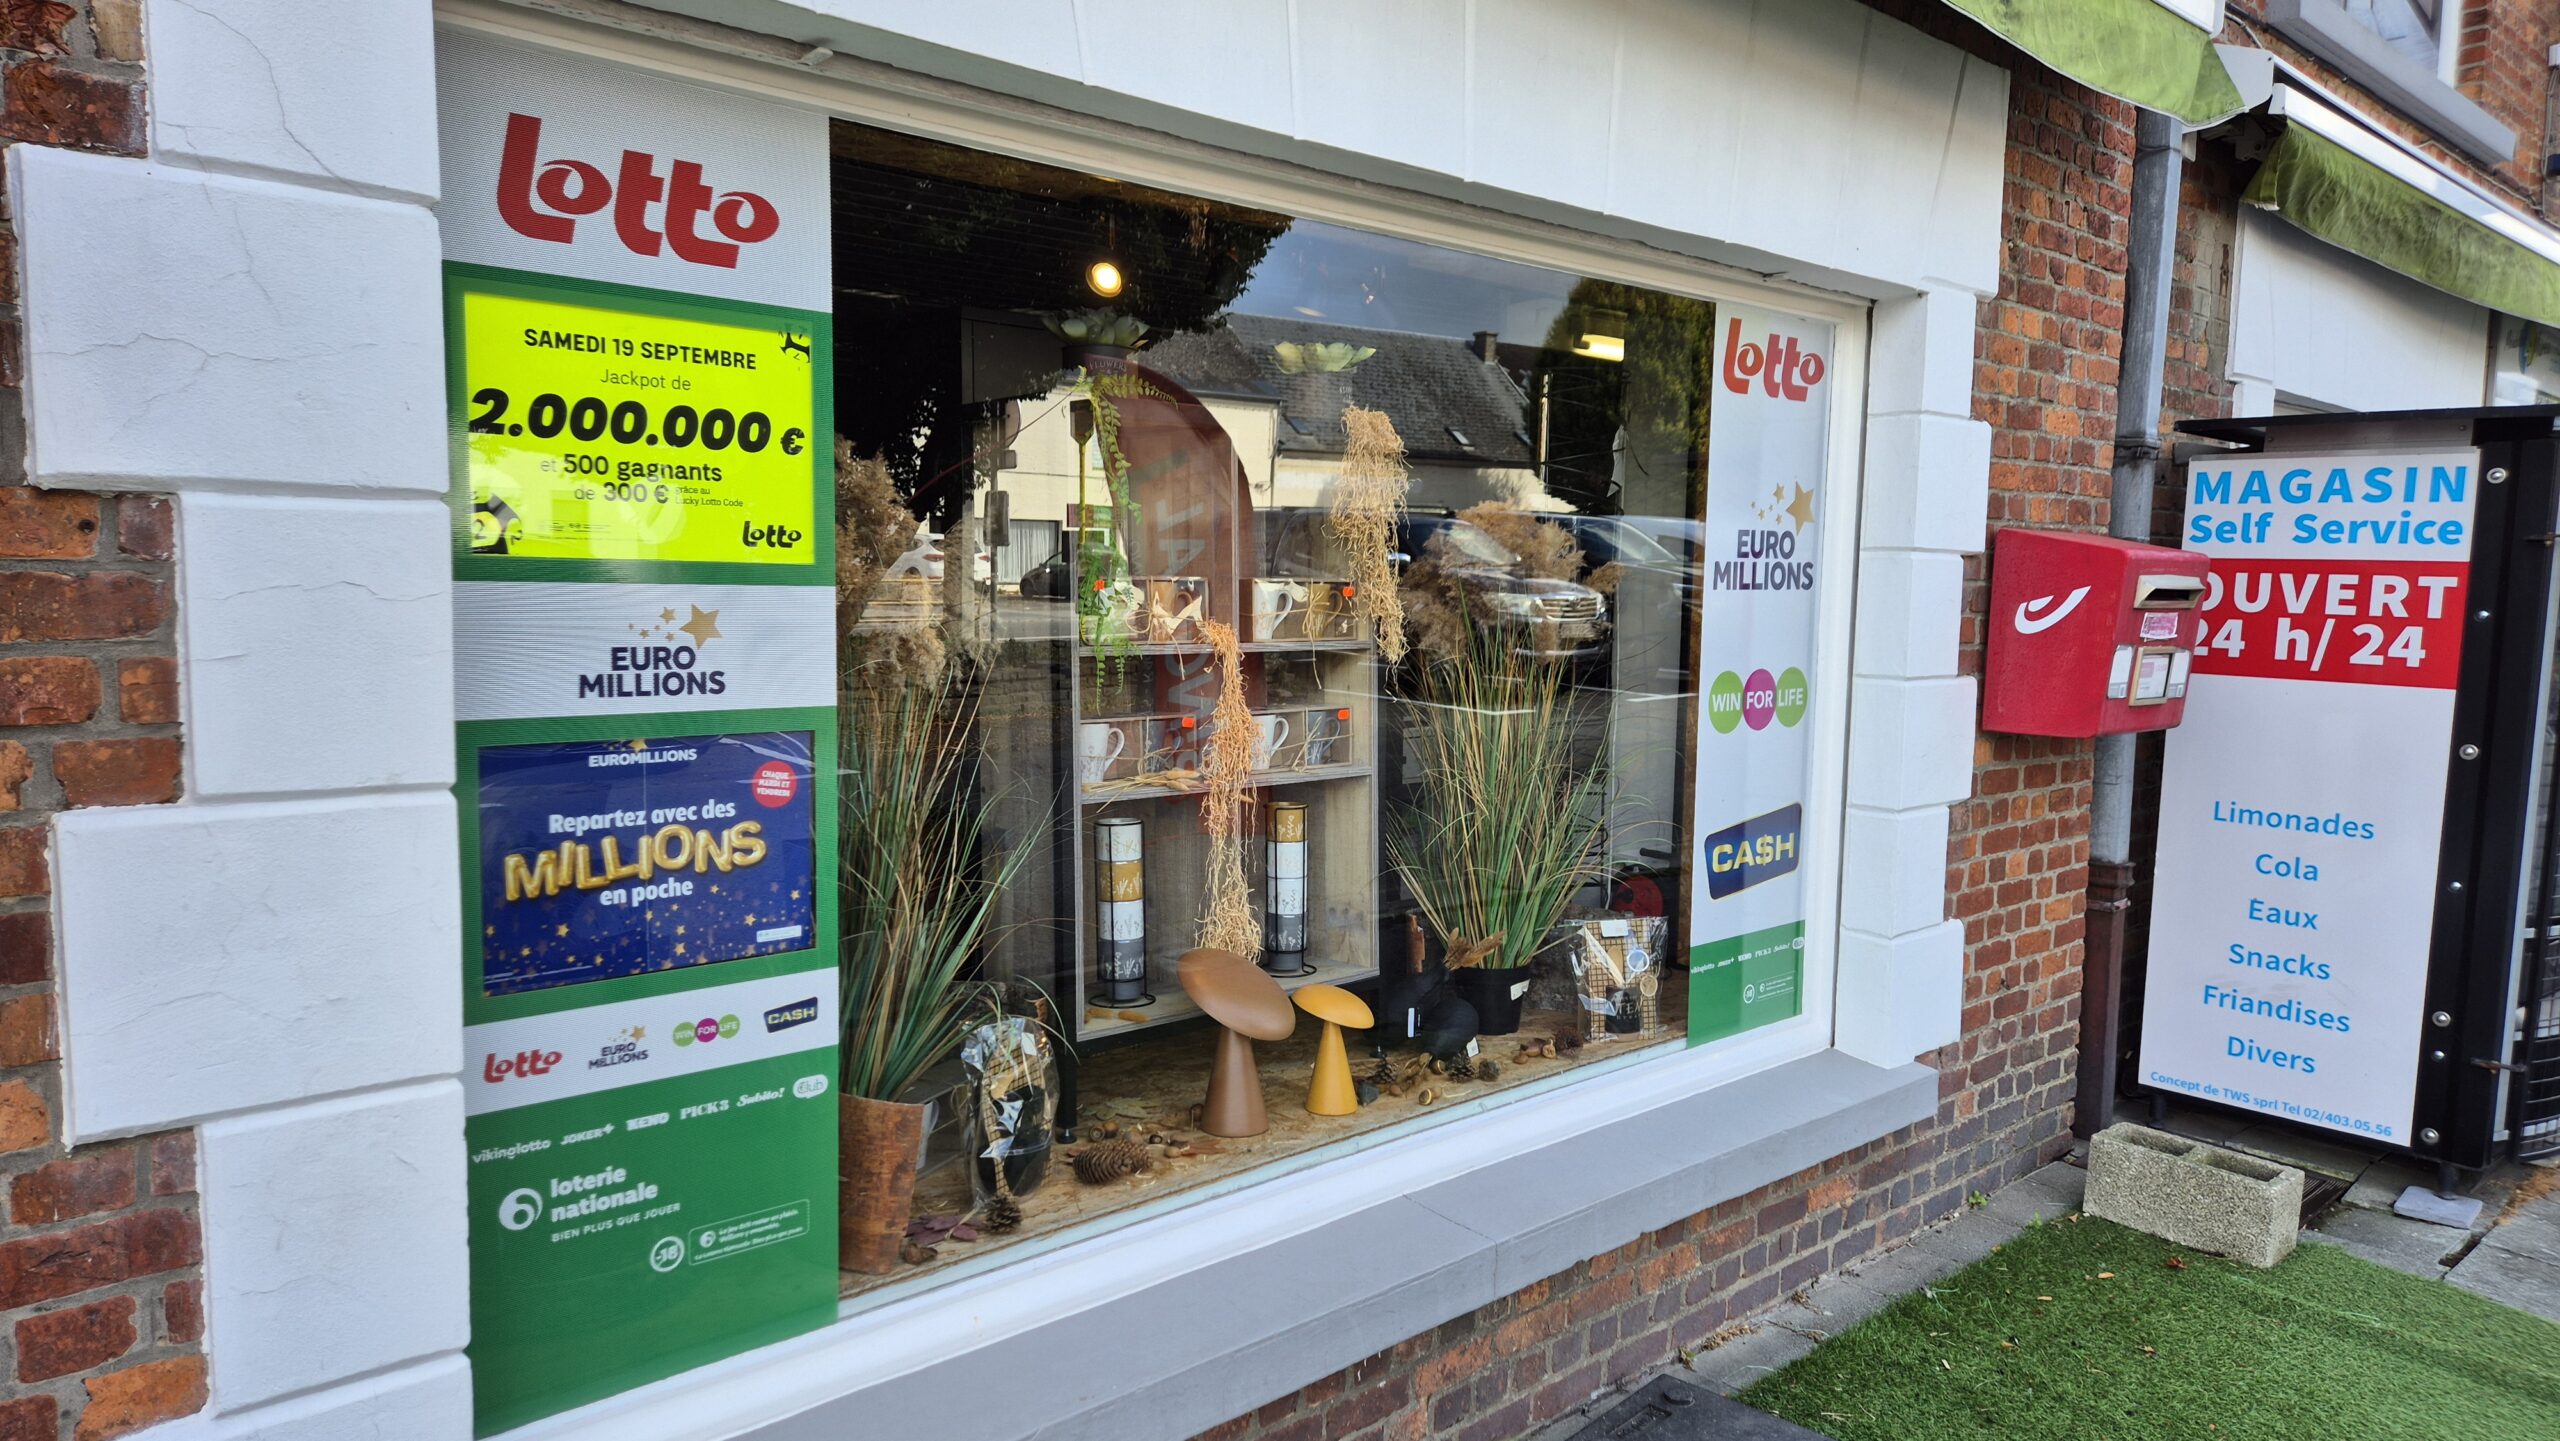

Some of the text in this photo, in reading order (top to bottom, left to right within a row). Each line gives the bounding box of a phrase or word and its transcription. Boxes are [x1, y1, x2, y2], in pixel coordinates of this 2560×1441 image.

[524, 328, 756, 370] SAMEDI 19 SEPTEMBRE
[600, 369, 691, 391] Jackpot de
[469, 388, 805, 455] 2.000.000 €
[541, 454, 723, 482] et 500 gagnants
[574, 482, 669, 503] de 300 €
[2194, 465, 2467, 505] MAGASIN
[723, 499, 743, 508] Code
[2189, 510, 2464, 545] Self Service
[1737, 529, 1795, 560] EURO
[1712, 560, 1814, 591] MILLIONS
[611, 645, 697, 672] EURO
[2349, 623, 2426, 668] 24
[579, 670, 726, 698] MILLIONS
[1711, 687, 1804, 713] WIN FOR LIFE
[588, 748, 698, 768] EUROMILLIONS
[548, 799, 735, 836] Repartez avec des
[2212, 800, 2375, 841] Limonades
[504, 820, 768, 902] MILLIONS
[2255, 853, 2319, 882] Cola
[600, 877, 693, 907] en poche
[2248, 899, 2319, 930] Eaux
[2228, 943, 2331, 981] Snacks
[2203, 984, 2351, 1033] Friandises
[674, 1021, 738, 1041] WIN FOR LIFE
[588, 1050, 649, 1070] MILLIONS
[601, 1042, 636, 1057] EURO
[2226, 1035, 2316, 1074] Divers
[2150, 1071, 2201, 1092] Concept
[2203, 1083, 2219, 1096] de
[2222, 1087, 2250, 1104] TWS
[2252, 1096, 2279, 1110] sprl
[2281, 1101, 2301, 1116] Tel
[551, 1165, 627, 1198] loterie
[551, 1181, 658, 1223] nationale
[551, 1202, 681, 1243] BIEN PLUS QUE JOUER
